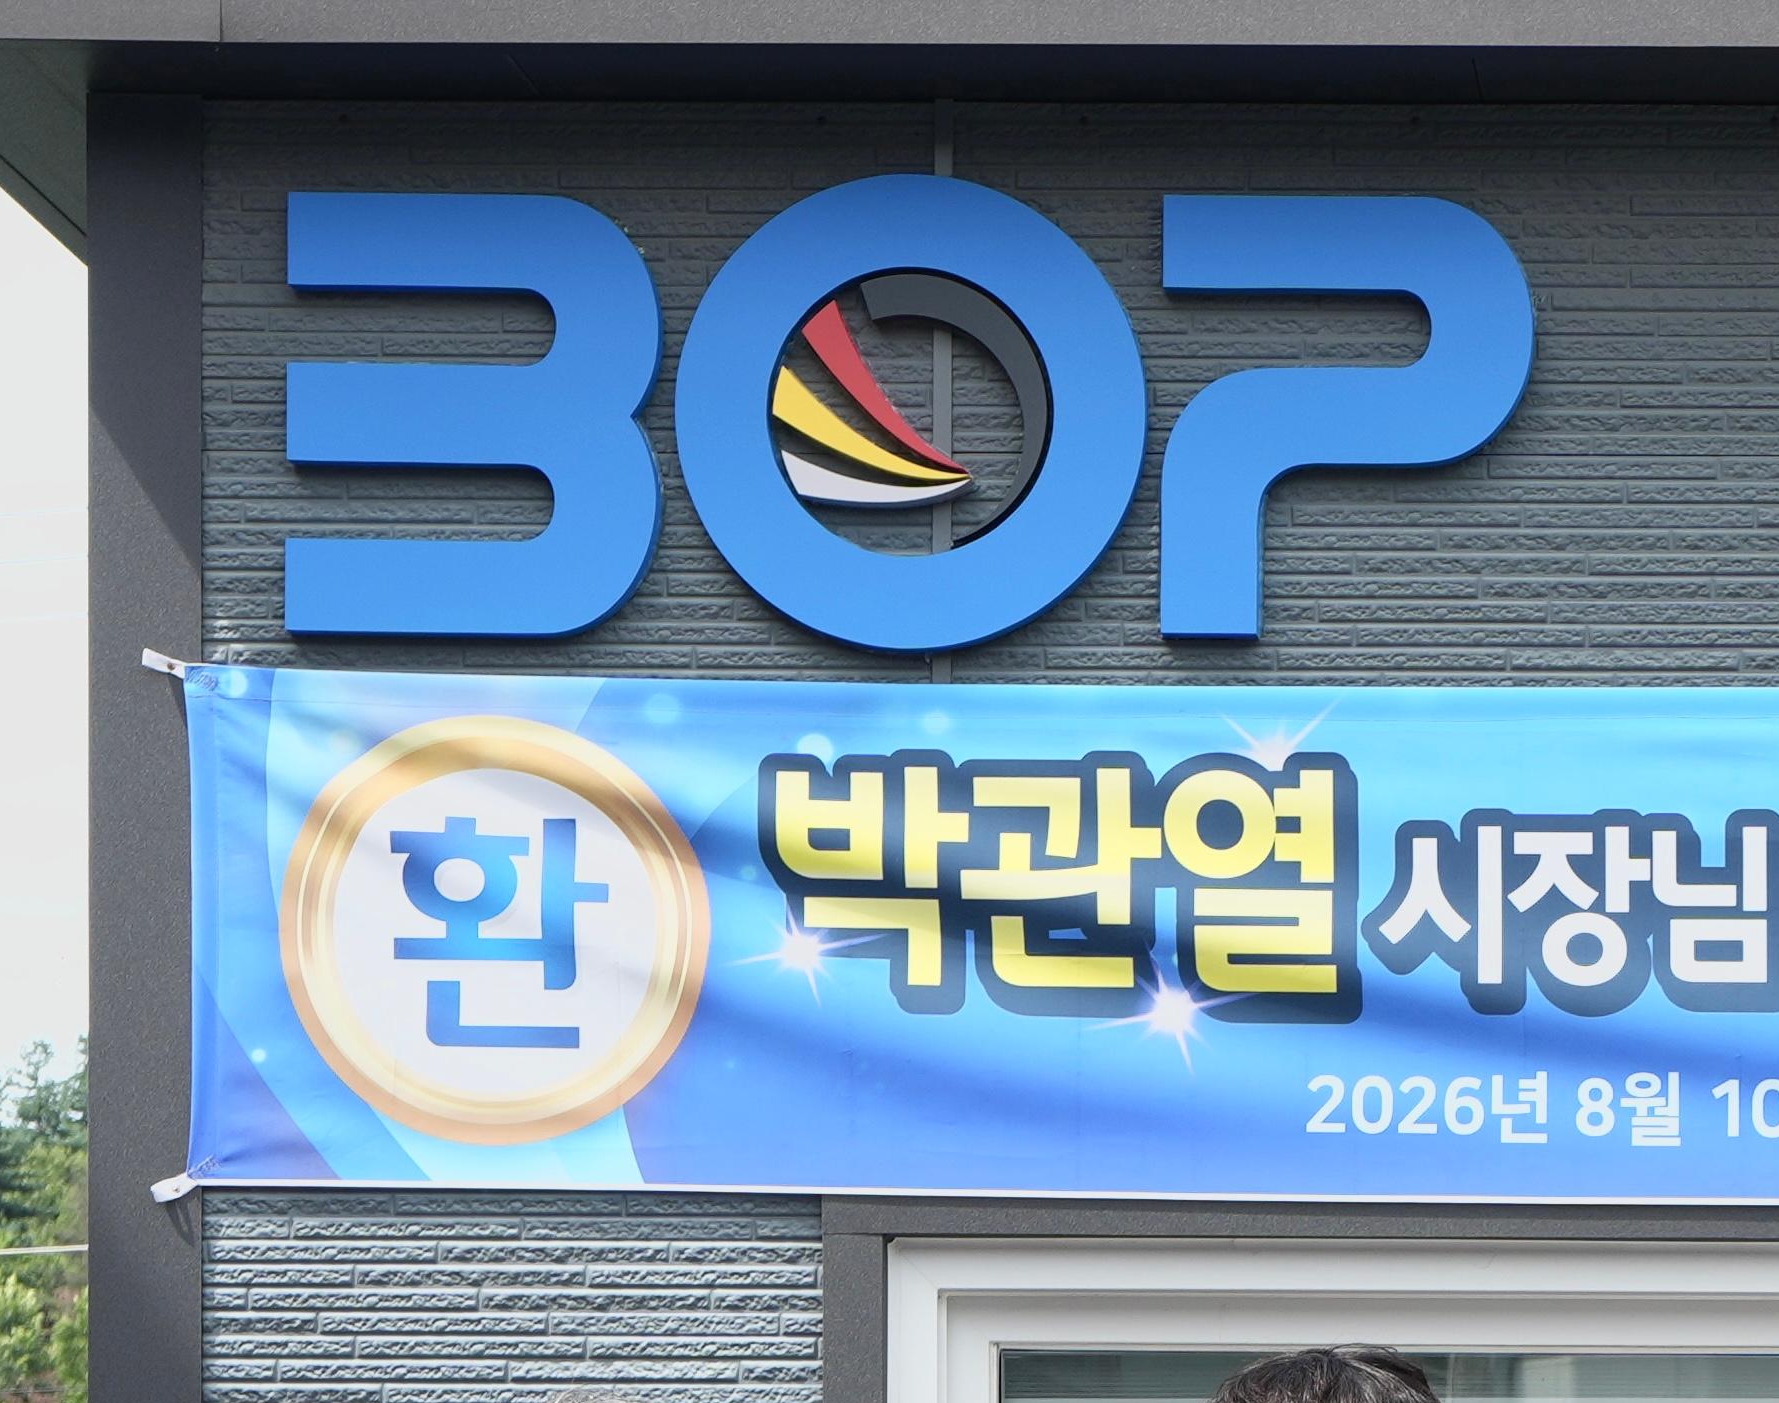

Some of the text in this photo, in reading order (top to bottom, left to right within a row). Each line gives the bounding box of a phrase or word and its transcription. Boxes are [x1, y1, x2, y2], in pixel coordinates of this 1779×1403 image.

[284, 172, 1538, 651] BOP
[390, 815, 609, 1049] 환
[775, 767, 1339, 994] 박관열
[1378, 824, 1768, 987] 시장님
[1305, 1070, 1549, 1145] 2026년
[1575, 1071, 1682, 1148] 8월
